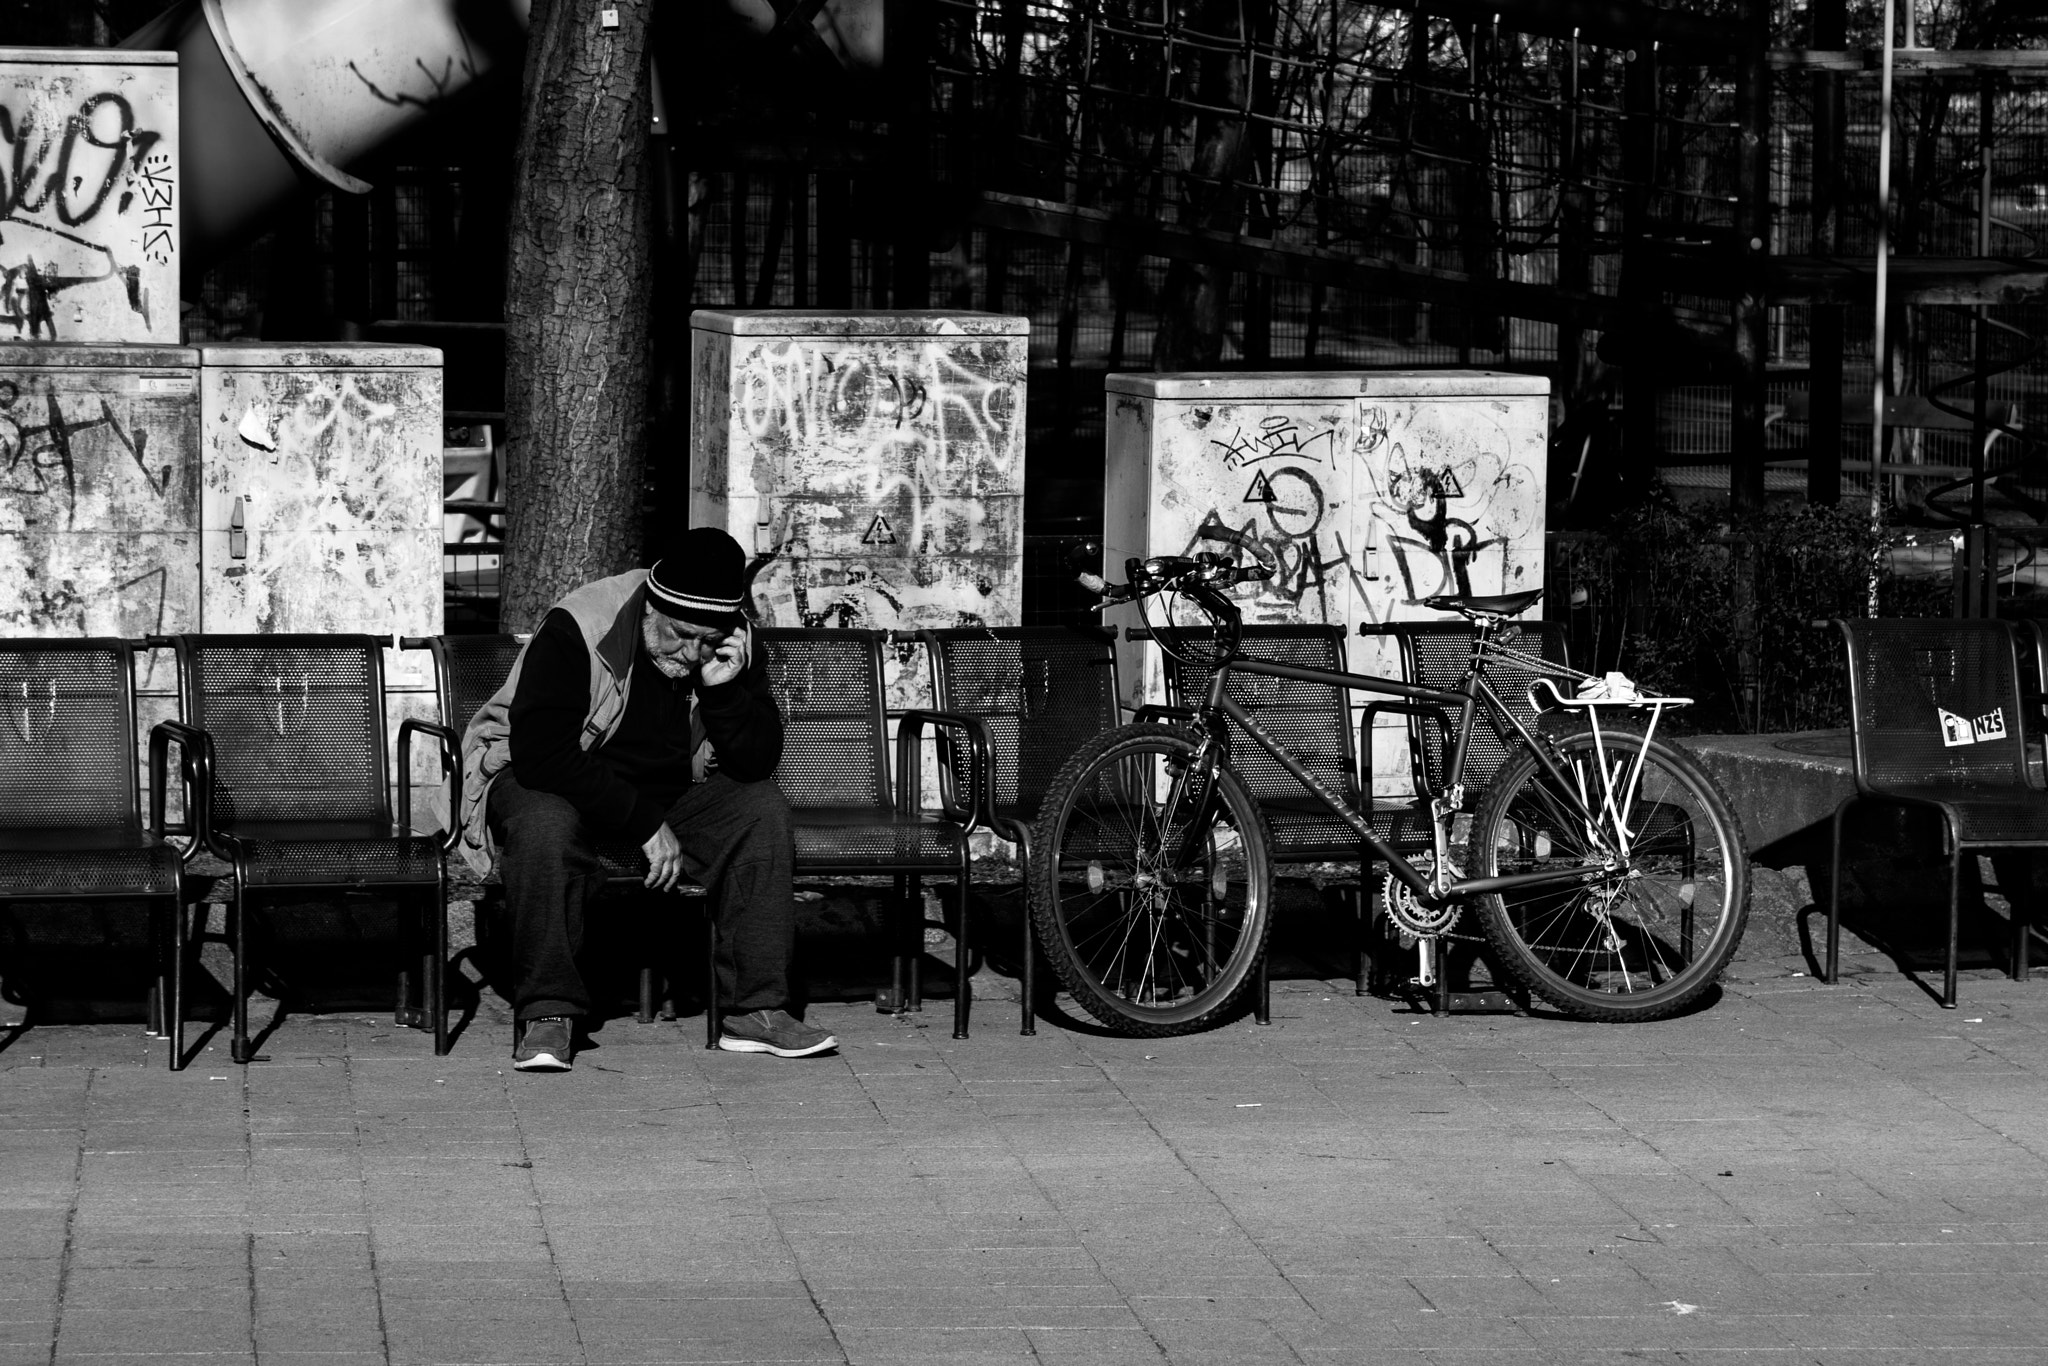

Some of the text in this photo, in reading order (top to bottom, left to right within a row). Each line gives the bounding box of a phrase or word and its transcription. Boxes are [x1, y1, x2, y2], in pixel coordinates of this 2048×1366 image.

[1975, 714, 2003, 735] NZS
[1244, 716, 1381, 843] ROCKY MOUNTAIN
